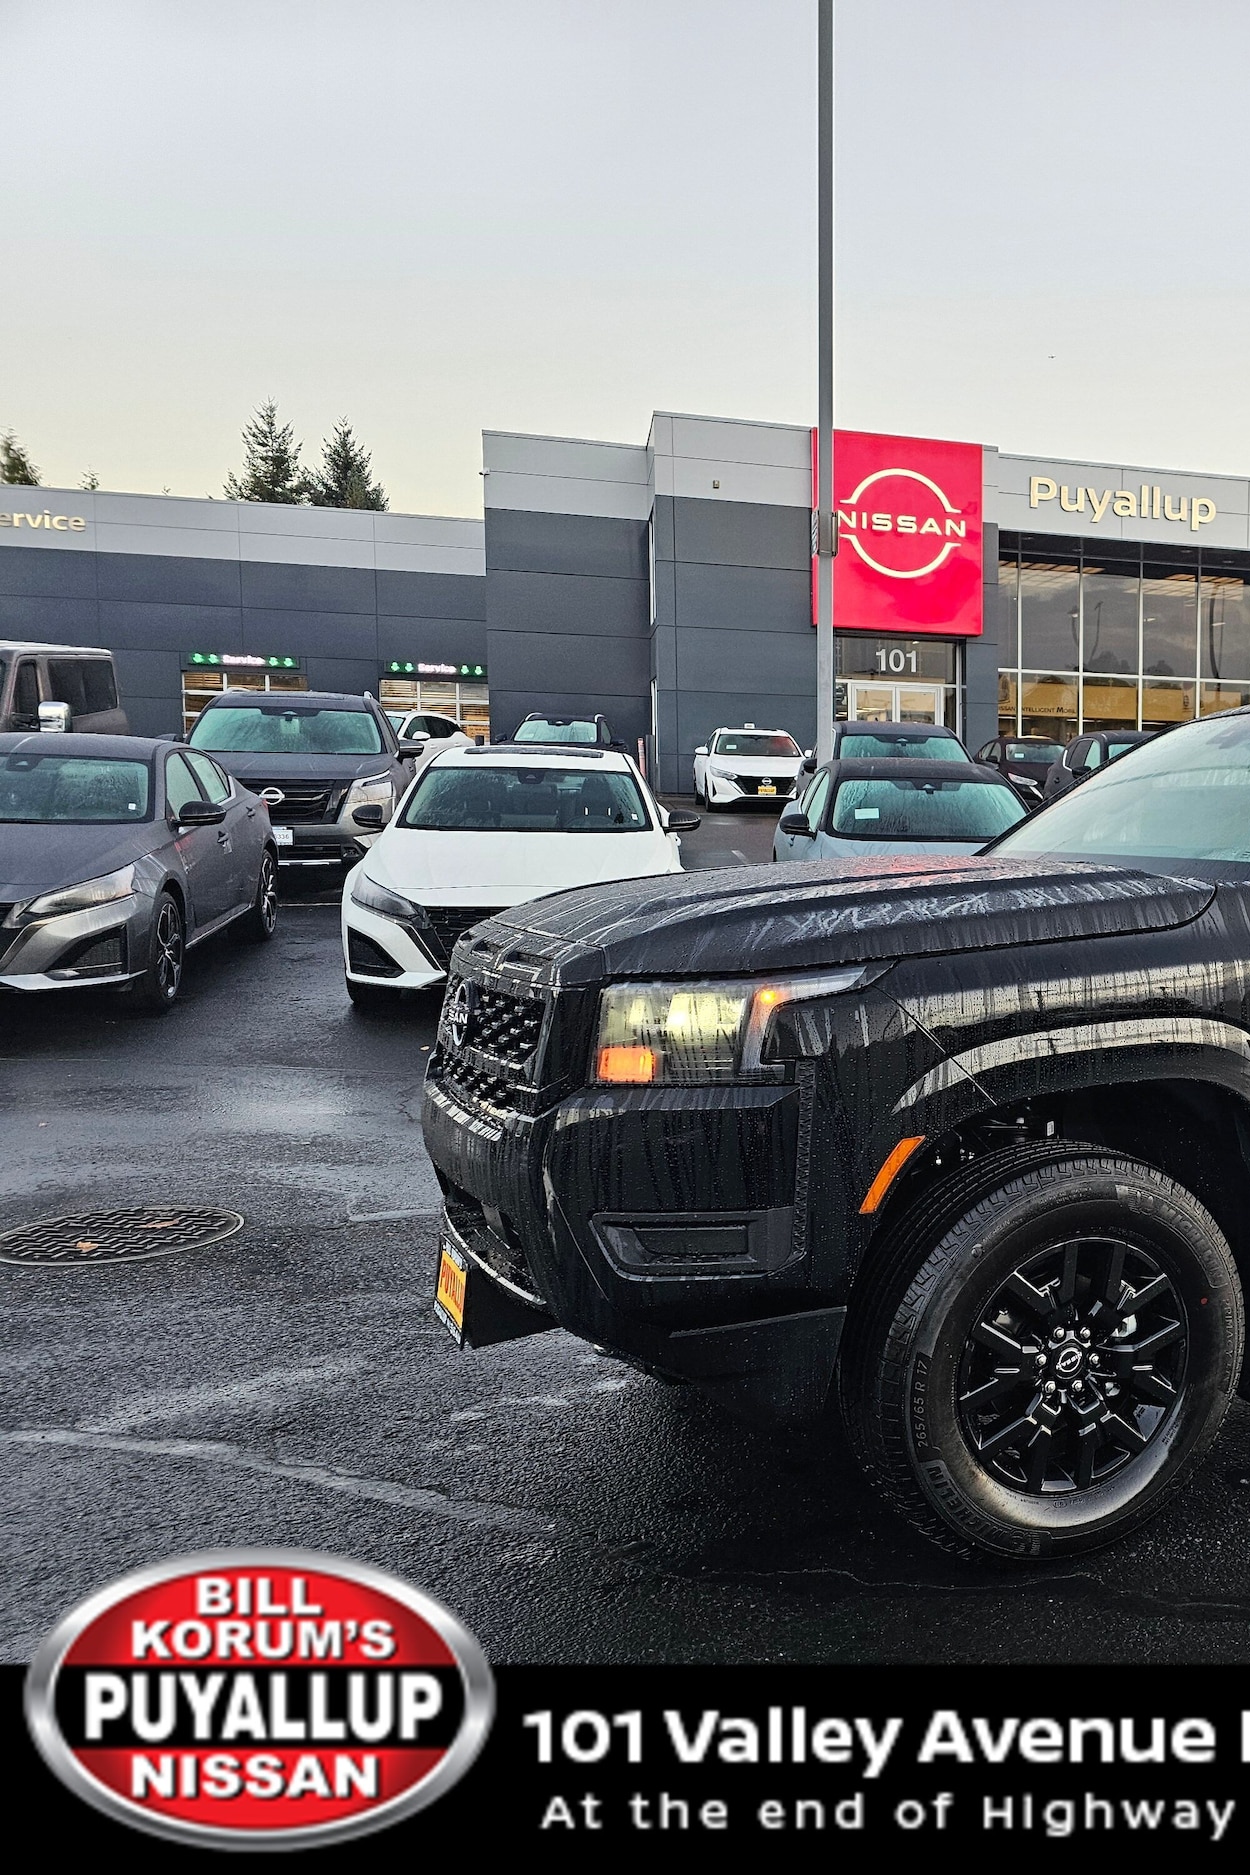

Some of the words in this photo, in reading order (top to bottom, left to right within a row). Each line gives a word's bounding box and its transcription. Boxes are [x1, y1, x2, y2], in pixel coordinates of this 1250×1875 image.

[1029, 476, 1217, 531] Puyallup
[837, 509, 966, 537] NISSAN
[876, 648, 917, 673] 101
